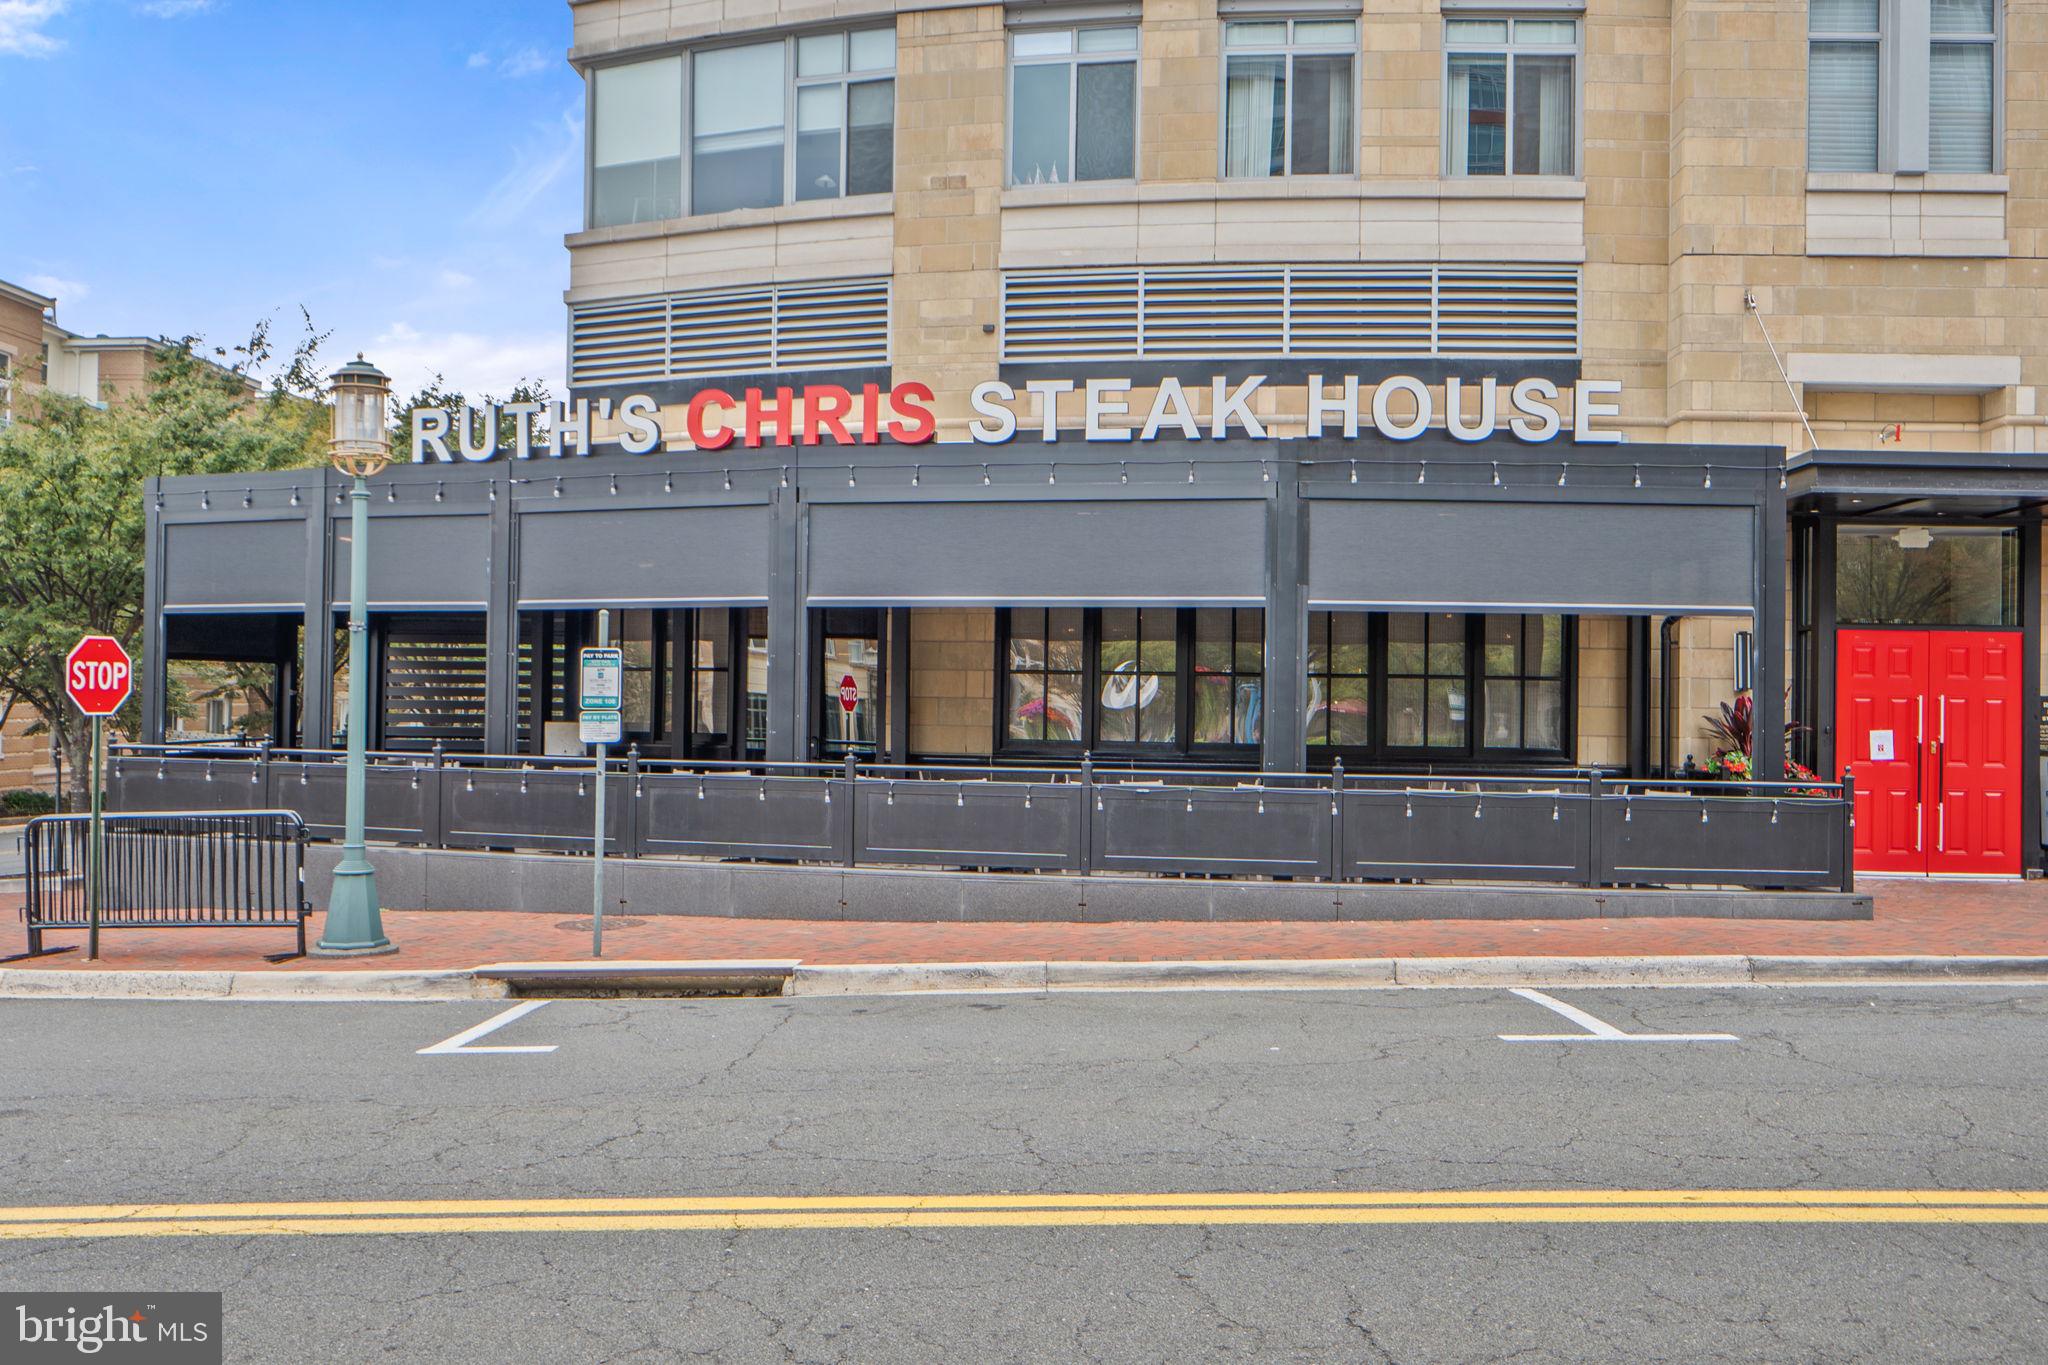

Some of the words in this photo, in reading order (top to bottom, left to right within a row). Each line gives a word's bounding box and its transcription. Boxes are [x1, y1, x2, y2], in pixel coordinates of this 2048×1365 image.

[411, 394, 662, 464] RUTH'S
[686, 381, 937, 451] CHRIS
[967, 374, 1269, 444] STEAK
[1306, 374, 1623, 444] HOUSE
[71, 661, 128, 690] STOP
